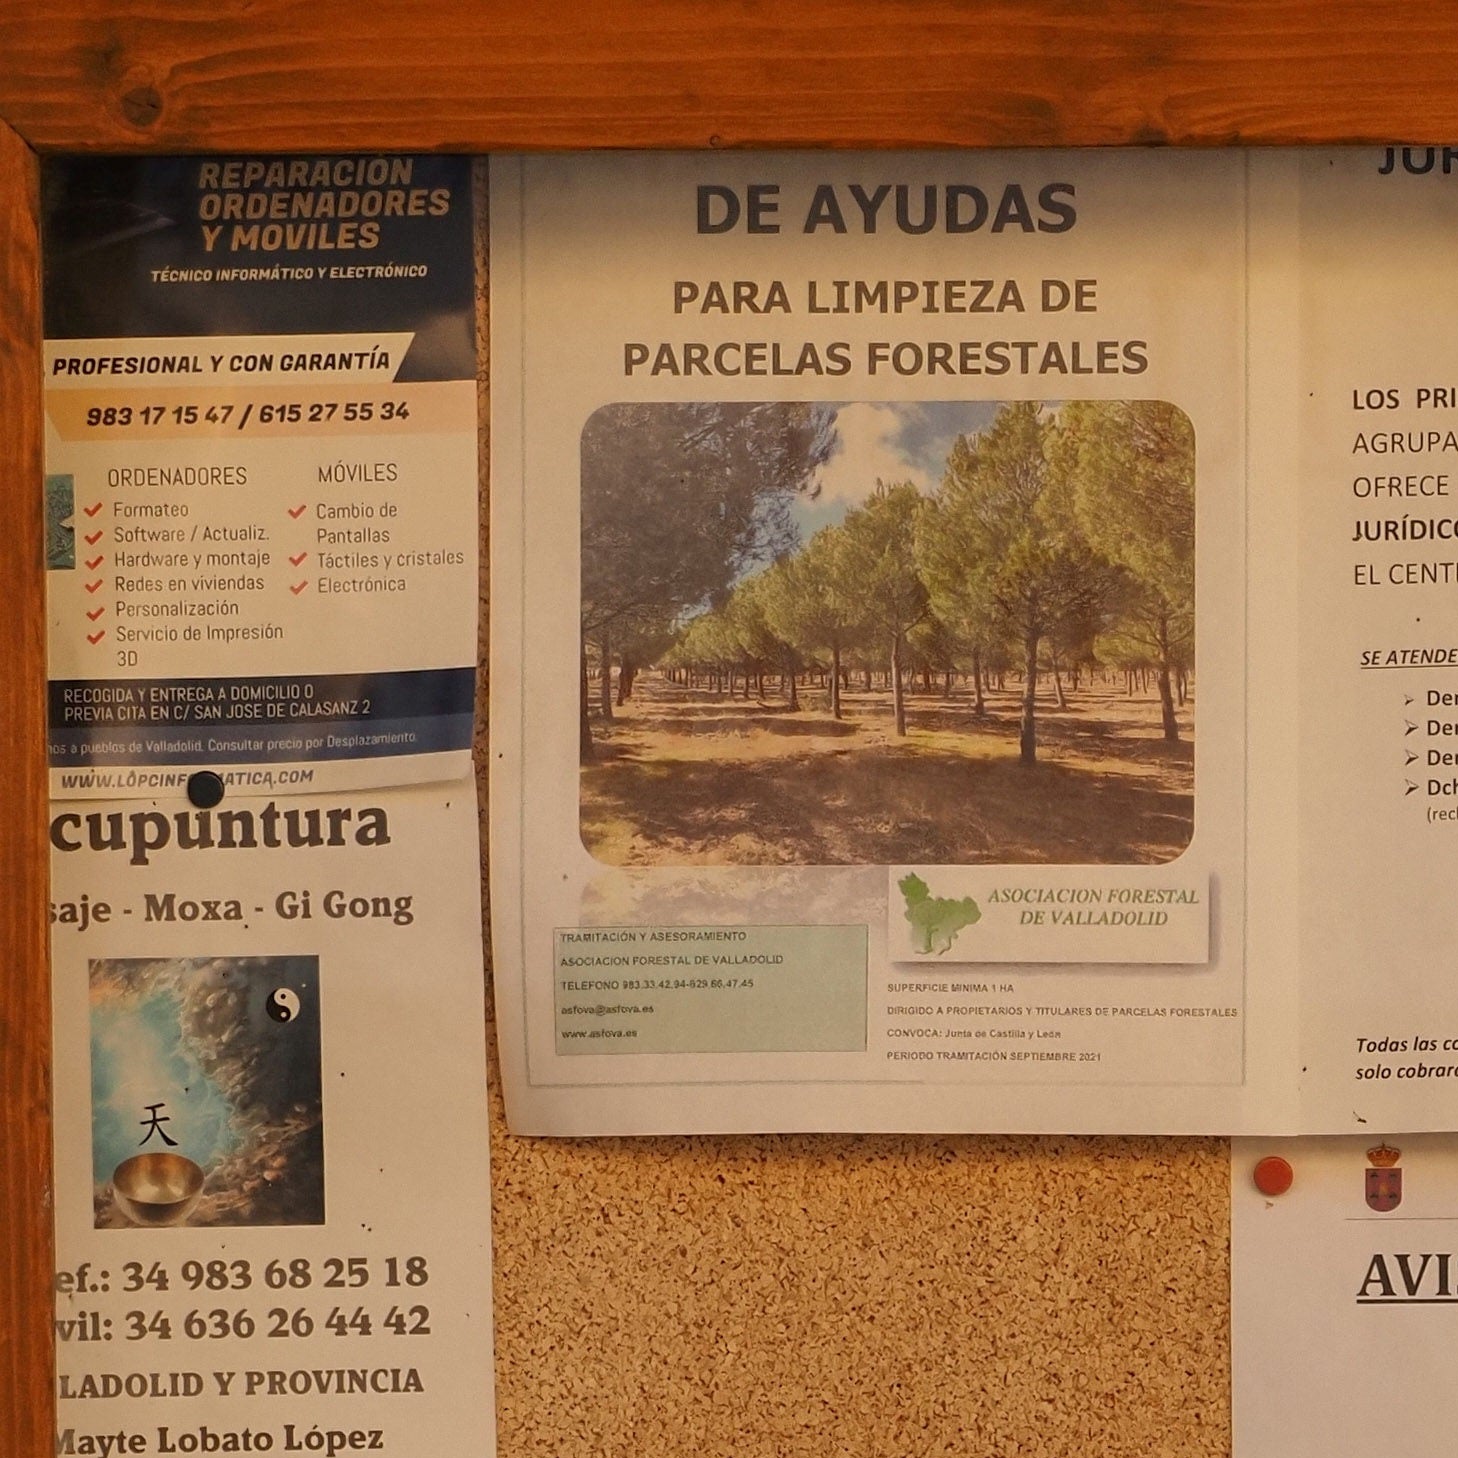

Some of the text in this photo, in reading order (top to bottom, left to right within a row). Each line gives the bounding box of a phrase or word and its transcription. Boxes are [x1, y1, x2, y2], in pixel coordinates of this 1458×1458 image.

[200, 189, 450, 220] ORDENADORES
[697, 183, 1076, 235] DE AYUDAS
[202, 222, 380, 251] Y MOVILES
[151, 266, 212, 282] TÉCNICO
[216, 264, 314, 281] INFORMÁTICO
[330, 263, 427, 278] ELECTRÓNICO
[674, 280, 1097, 314] PARA LIMPIEZA DE
[625, 341, 1148, 376] PARCELAS FORESTALES
[1353, 389, 1399, 410] LOS
[108, 466, 247, 487] ORDENADORES
[318, 461, 397, 483] MÓVILES
[318, 576, 406, 593] Electrónica
[116, 599, 238, 617] Personalización
[144, 894, 243, 921] Moxa
[275, 890, 312, 919] Gi
[323, 890, 414, 926] Gong
[988, 888, 1199, 904] ASOCIACION FORESTAL
[1020, 910, 1168, 926] DE VALLADOLID
[213, 1369, 424, 1396] Y PROVINCIA
[157, 1425, 383, 1458] Lobato López
